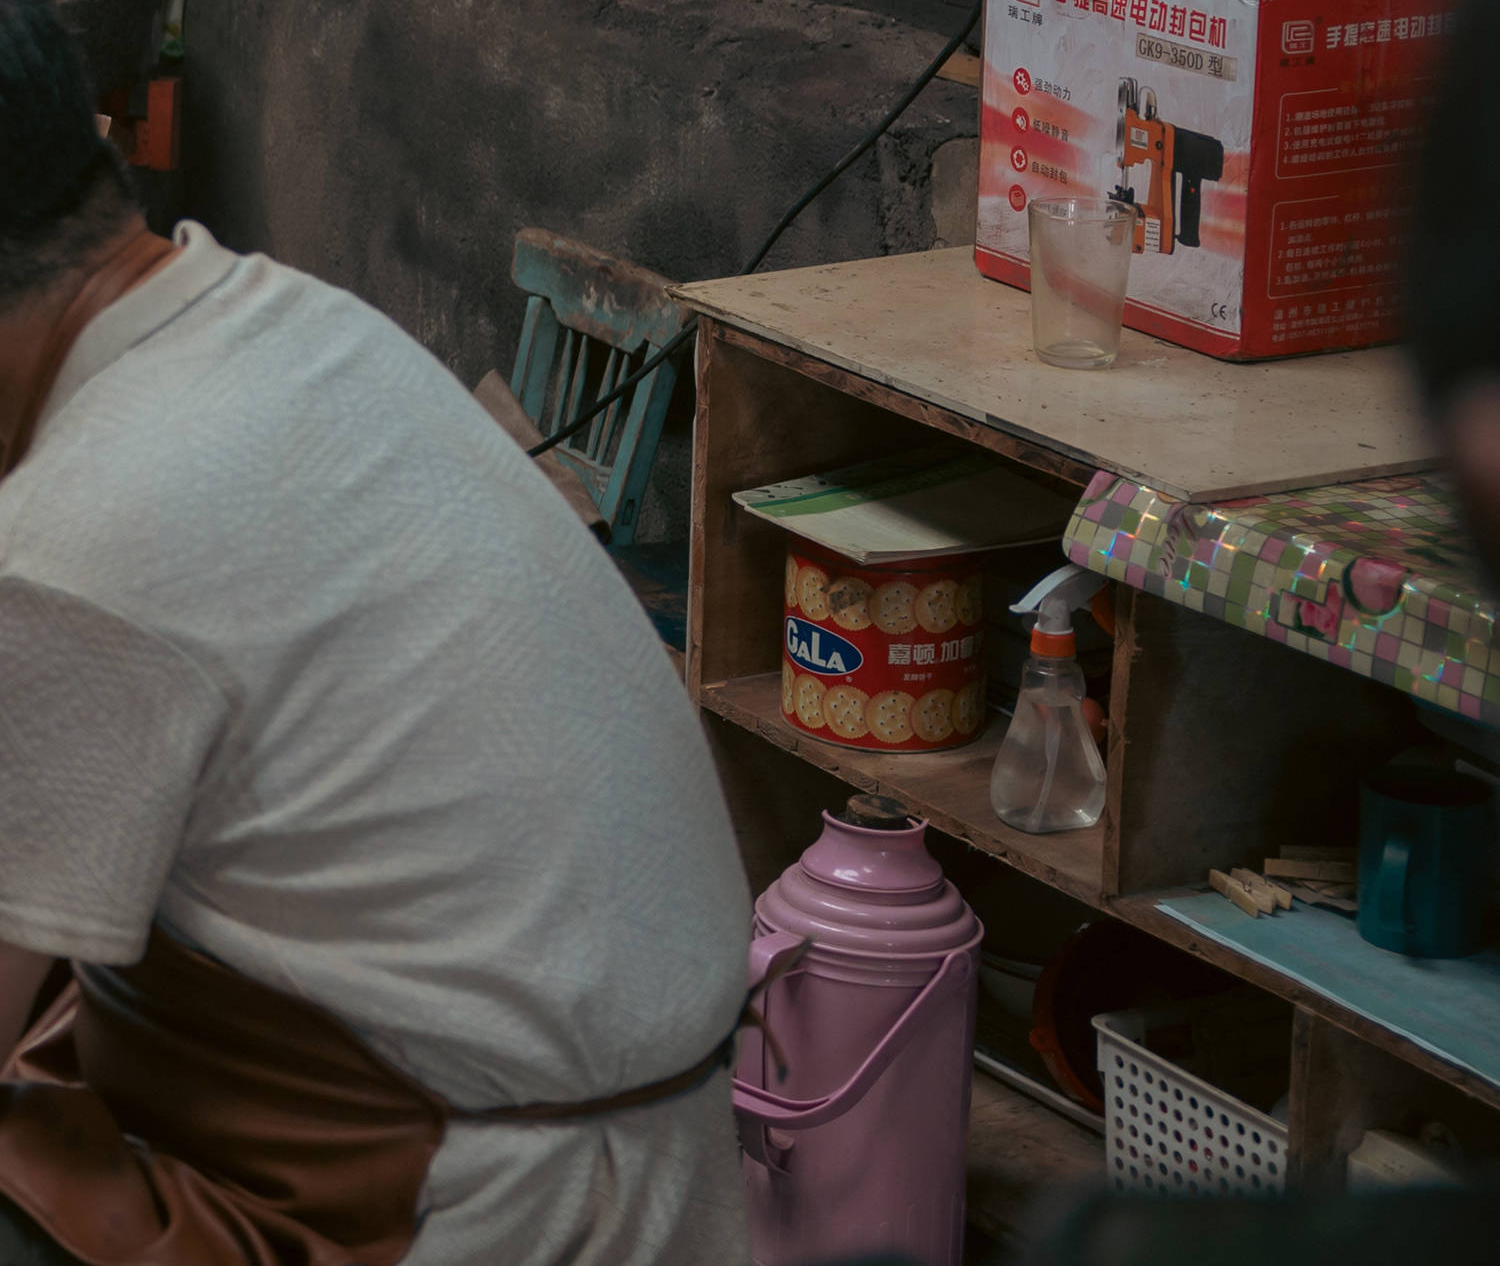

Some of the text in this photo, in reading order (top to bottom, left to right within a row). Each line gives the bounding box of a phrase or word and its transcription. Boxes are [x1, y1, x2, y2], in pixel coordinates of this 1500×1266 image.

[1138, 38, 1224, 77] GK9-350D 型
[1034, 77, 1072, 101] 强劲动力
[1033, 118, 1069, 142] 低噪静音
[1031, 161, 1068, 184] 自动封包
[786, 618, 848, 673] GALA
[887, 643, 936, 666] 嘉顿
